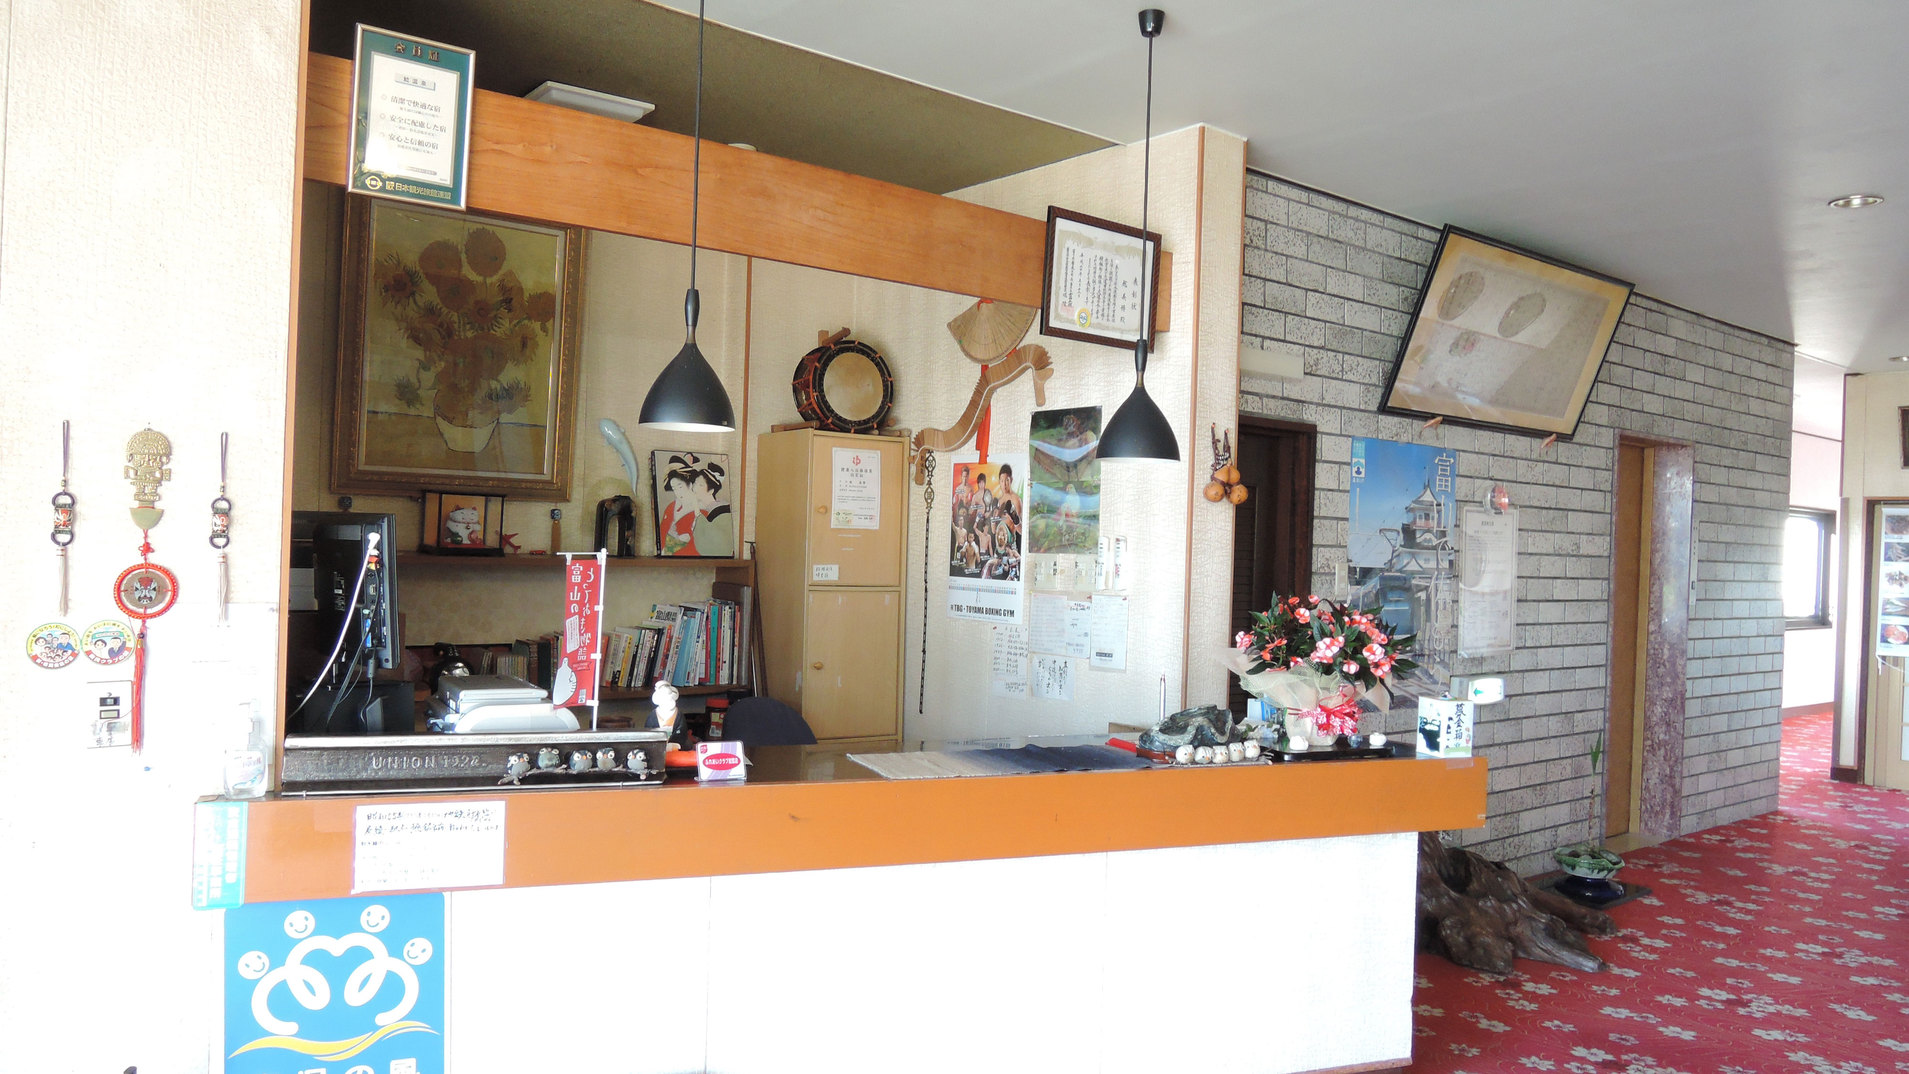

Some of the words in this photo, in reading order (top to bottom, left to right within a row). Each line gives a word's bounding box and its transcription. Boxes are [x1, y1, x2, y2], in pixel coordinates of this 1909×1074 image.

[390, 114, 447, 133] 安全に配慮した宿
[388, 132, 439, 150] 安心と信頼の宿
[966, 605, 985, 615] TOYAMA
[985, 607, 1002, 617] BOXING
[1002, 608, 1015, 618] GYM
[372, 756, 436, 769] UNION
